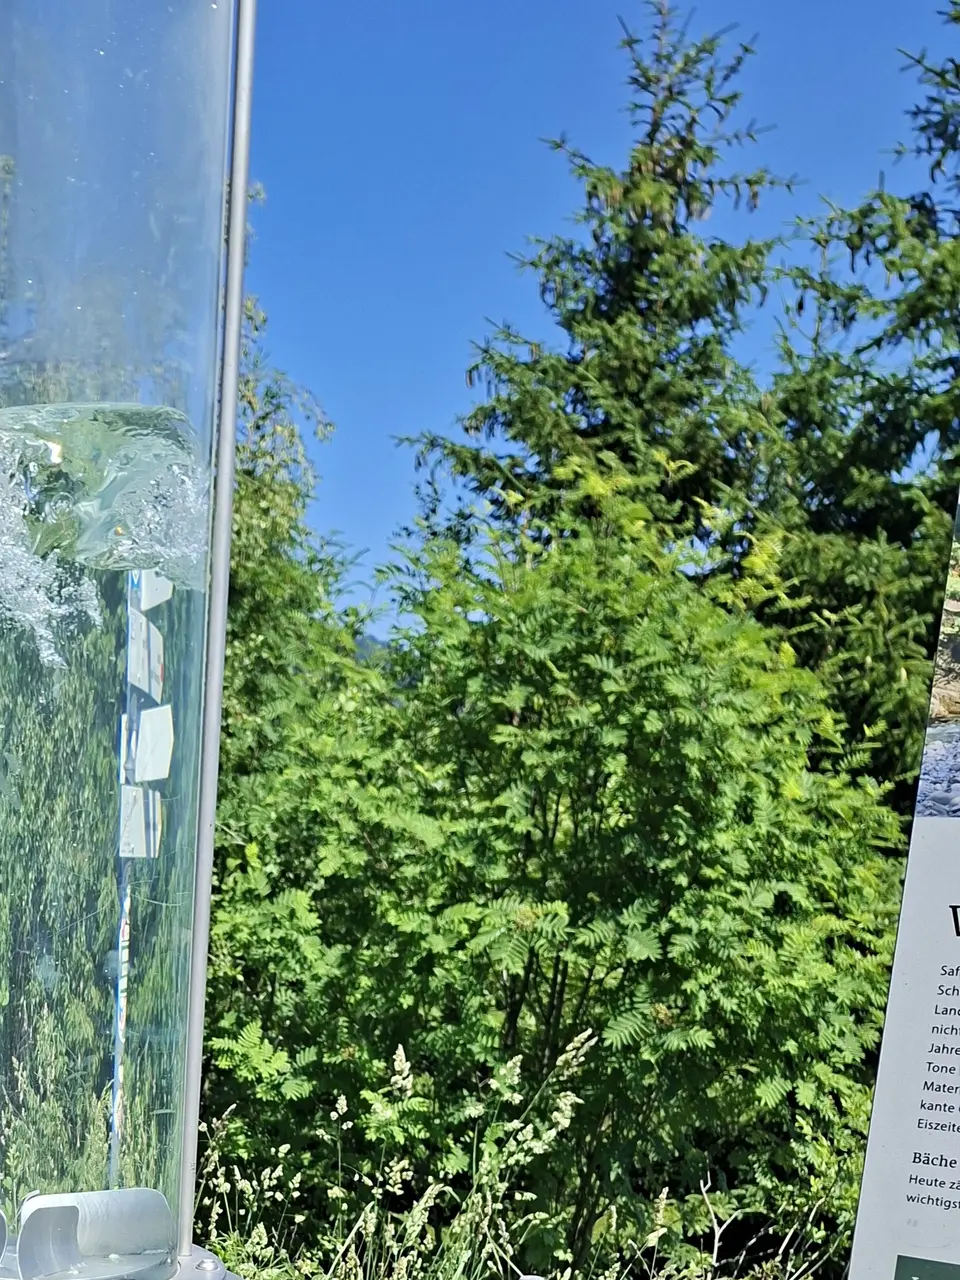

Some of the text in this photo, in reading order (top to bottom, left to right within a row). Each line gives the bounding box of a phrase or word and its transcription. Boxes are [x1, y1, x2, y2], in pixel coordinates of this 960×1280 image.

[926, 1061, 956, 1075] Tone
[920, 1099, 955, 1114] kante
[911, 1151, 958, 1169] Bäche
[908, 1173, 946, 1189] Heute
